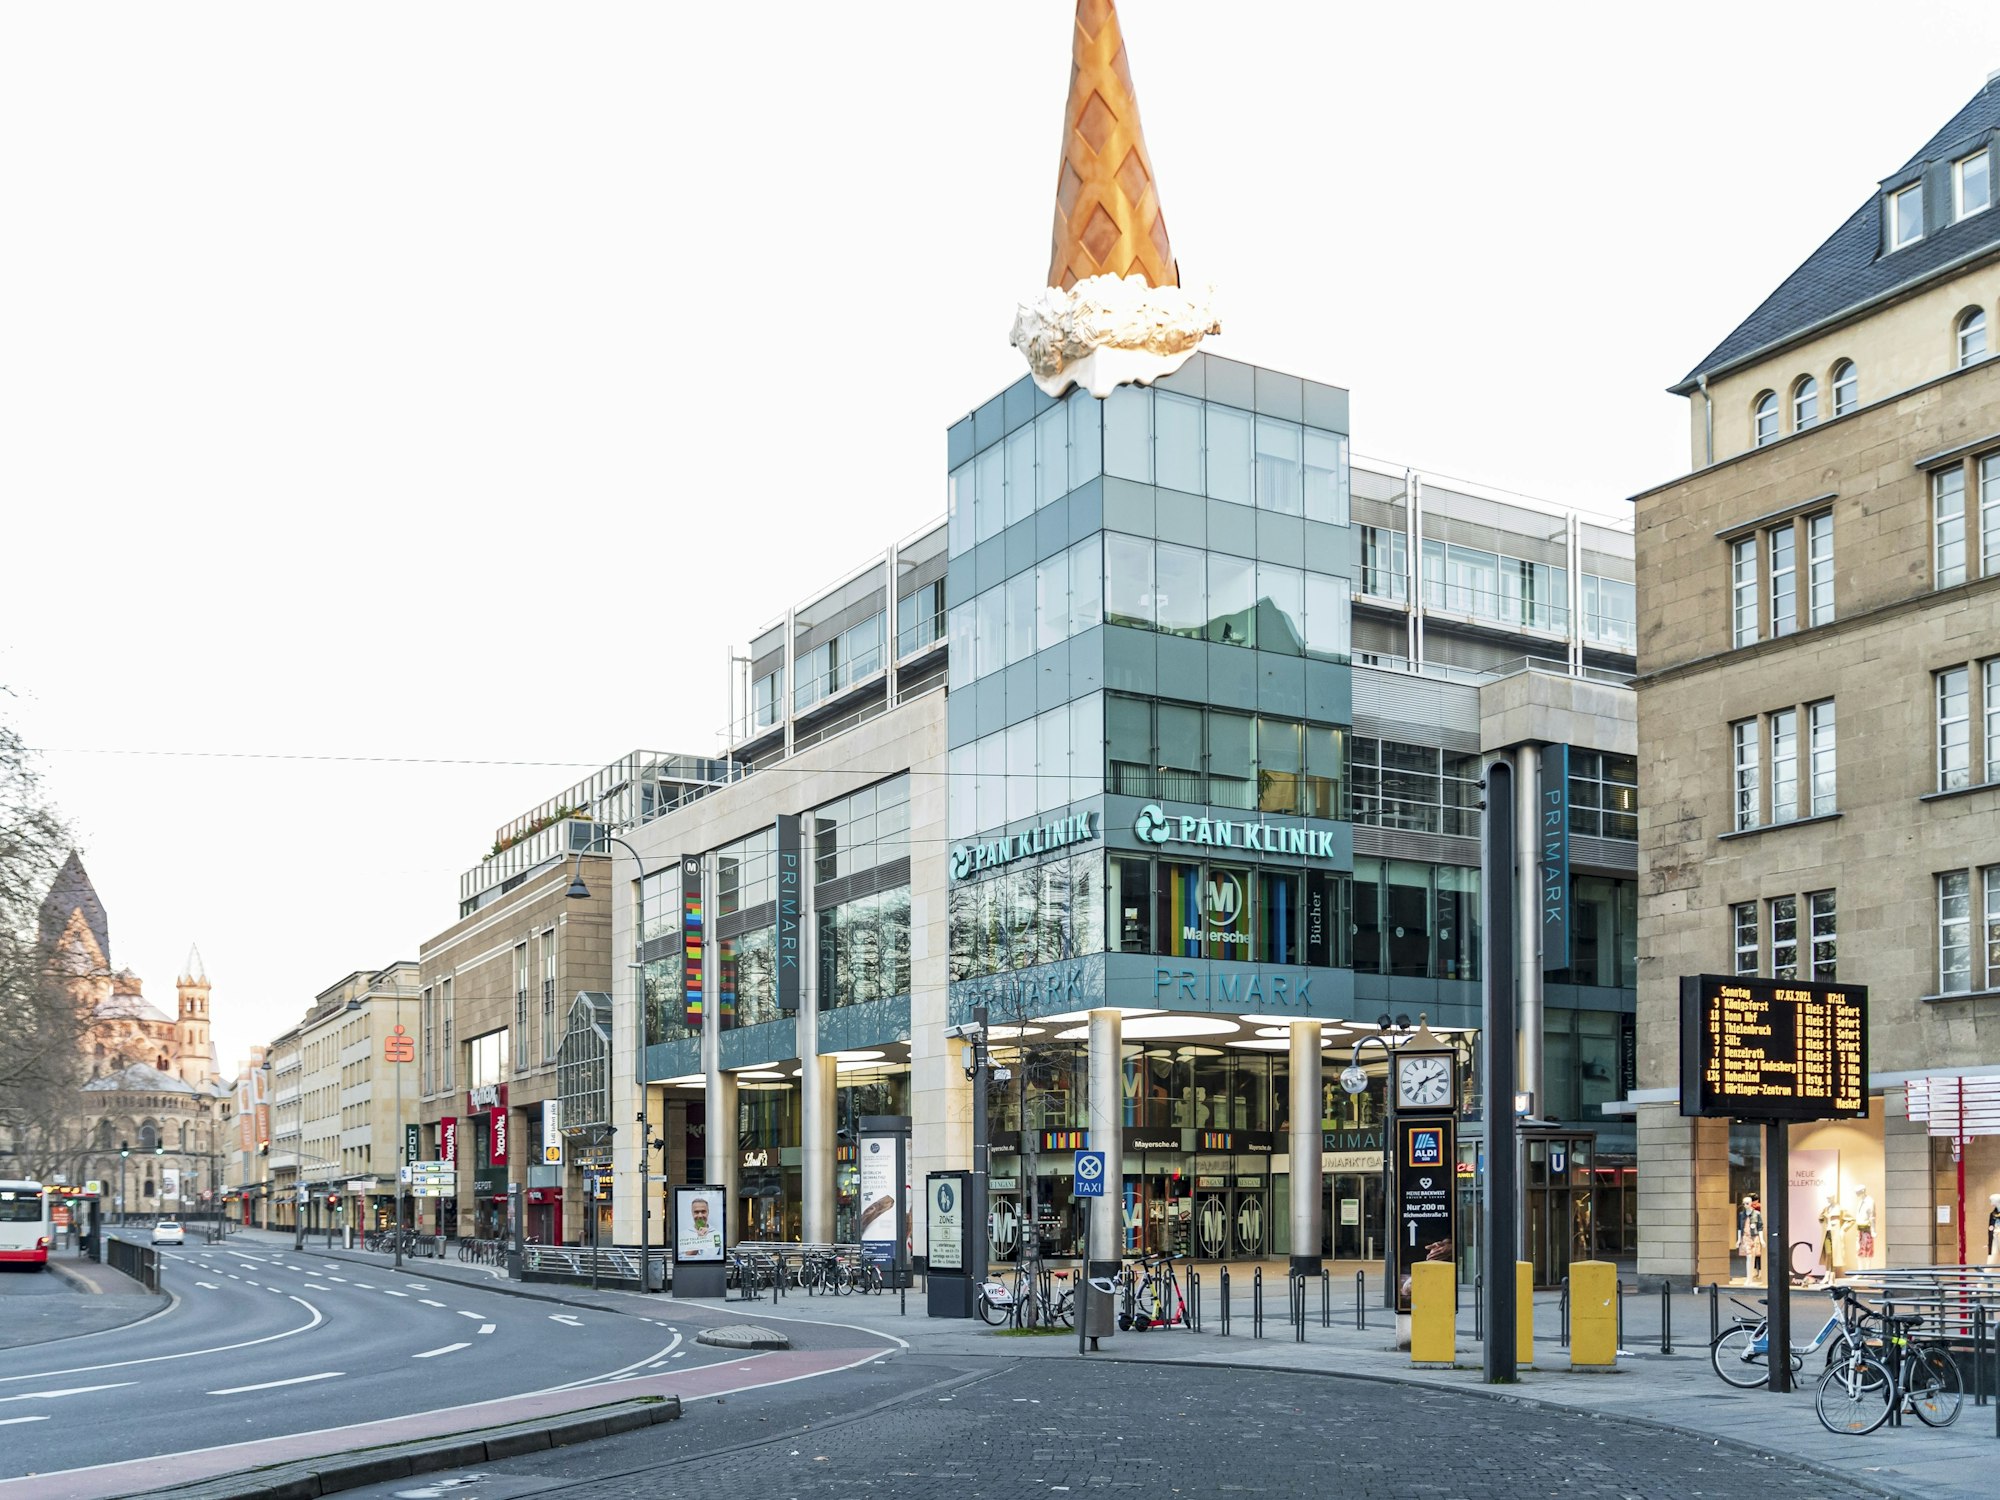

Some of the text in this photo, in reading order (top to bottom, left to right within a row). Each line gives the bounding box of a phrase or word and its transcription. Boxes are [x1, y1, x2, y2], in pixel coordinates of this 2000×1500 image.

[975, 811, 1092, 870] PAN KLINIK
[1181, 815, 1335, 859] PAN KLINIK
[1545, 790, 1561, 925] PRIMARK
[782, 853, 797, 969] PRIMARK
[1310, 891, 1323, 945] Bücher
[1183, 926, 1250, 945] Maersche
[966, 969, 1082, 1018] PRIMARK
[1154, 967, 1313, 1007] PRIMARK
[1721, 985, 1751, 1000] Sonntag
[1775, 989, 1812, 1003] 07.03.2021
[1714, 997, 1860, 1017] 9 Königsforst Gleis 3 Sofort
[1724, 1010, 1742, 1022] Bonn
[1805, 1015, 1824, 1026] Gleis
[1826, 1016, 1832, 1027] 2
[1836, 1017, 1860, 1028] Sofort
[1724, 1022, 1772, 1036] Thielenbruch
[1805, 1026, 1824, 1038] Gleis
[1826, 1028, 1832, 1038] 1
[1836, 1028, 1860, 1040] Sofort
[1714, 1033, 1860, 1052] 9 Sülz Gleis 4 Sofort
[1624, 1031, 1633, 1088] nderwelt
[1714, 1046, 1860, 1063] 7 Benzelrath Gleis 5 5 Min
[1724, 1059, 1758, 1071] Bonn-Bad
[1760, 1060, 1796, 1074] Godesberg
[1805, 1062, 1824, 1074] Gleis
[1826, 1063, 1832, 1074] 2
[1848, 1064, 1860, 1075] Min
[1724, 1070, 1760, 1083] Hohenlind
[1840, 1075, 1846, 1086] 7
[1848, 1075, 1860, 1086] Min
[1714, 1083, 1720, 1094] 3
[1724, 1083, 1792, 1096] Görlinger-Zentrum
[1805, 1086, 1824, 1097] Gleis
[1826, 1087, 1832, 1098] 1
[1848, 1086, 1860, 1098] Min
[1836, 1098, 1861, 1110] Maske?
[990, 1144, 1015, 1153] ayersche.de
[1134, 1139, 1179, 1151] Mayersche.de
[1414, 1149, 1437, 1158] ALDI
[1552, 1154, 1565, 1172] U
[1796, 1170, 1815, 1178] NEUE
[474, 1180, 492, 1190] DEPOT
[1077, 1182, 1102, 1193] TAXI
[938, 1216, 954, 1224] ZONE
